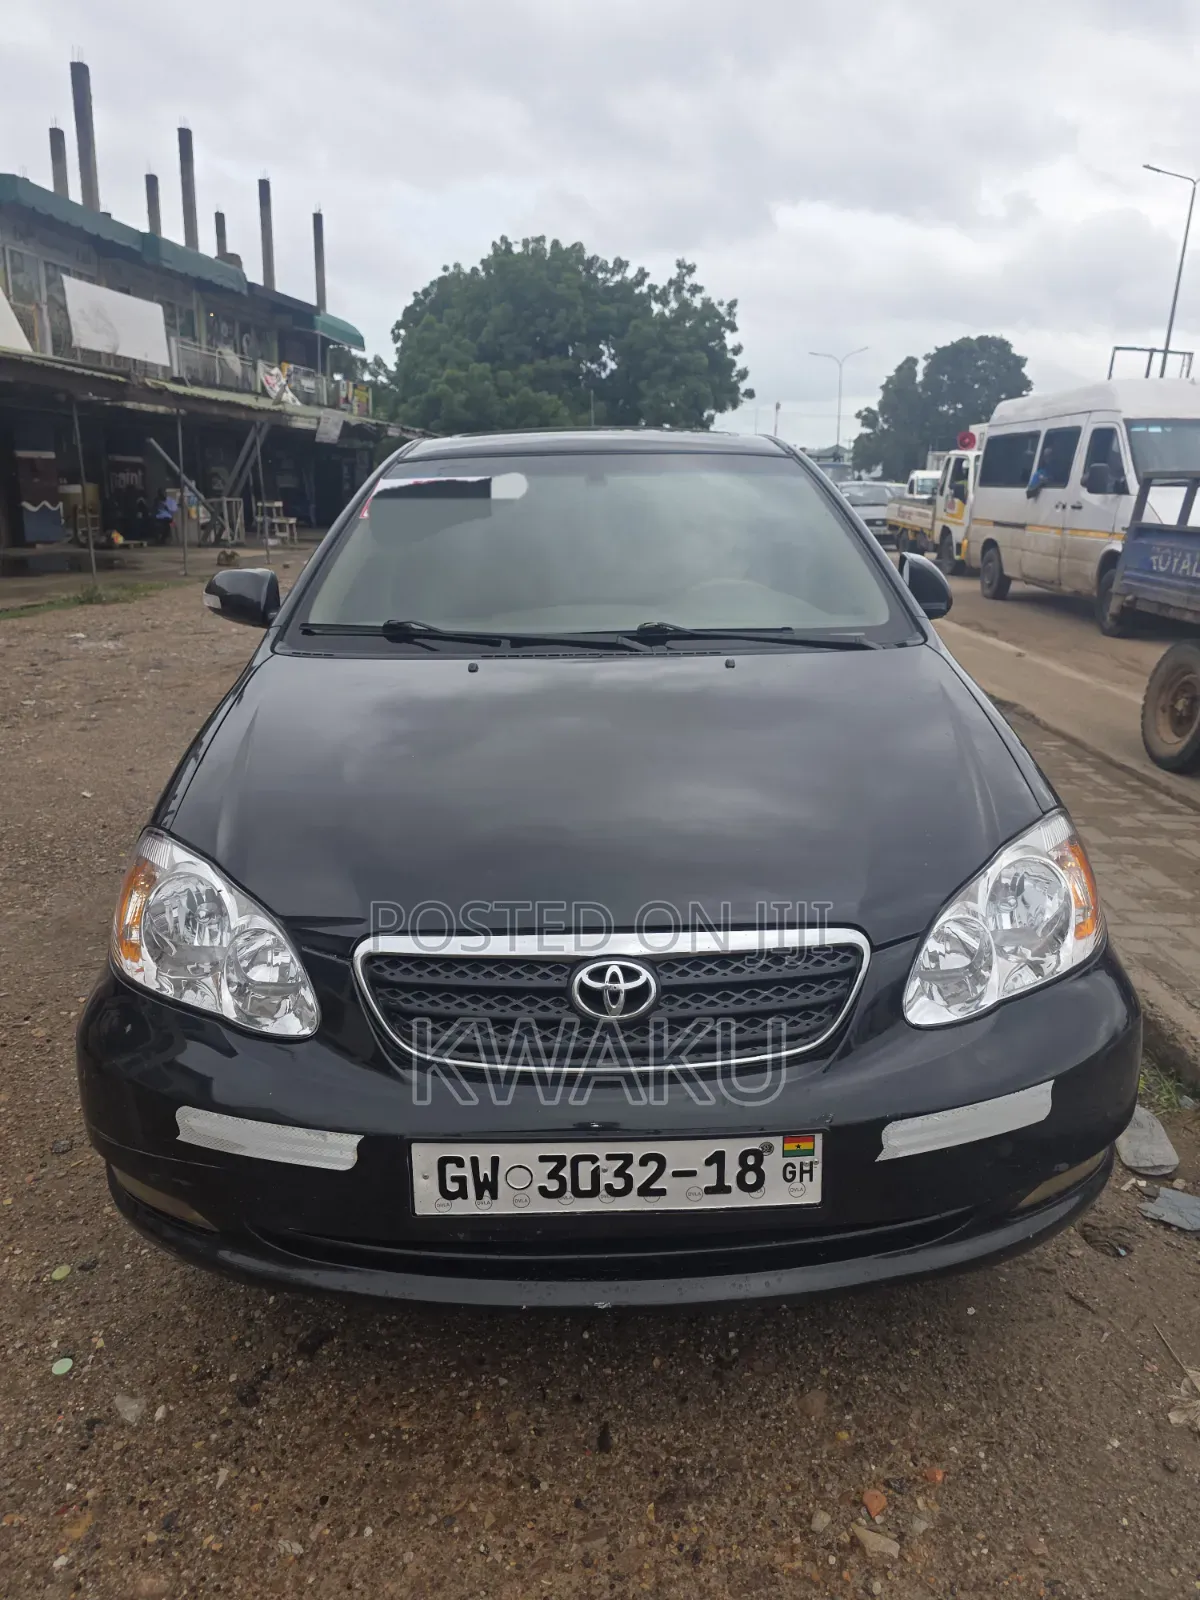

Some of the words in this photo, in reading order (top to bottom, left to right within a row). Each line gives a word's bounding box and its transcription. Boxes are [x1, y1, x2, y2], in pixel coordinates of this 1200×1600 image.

[437, 1155, 500, 1201] GW
[538, 1148, 766, 1200] 3032-18
[782, 1161, 814, 1183] GH
